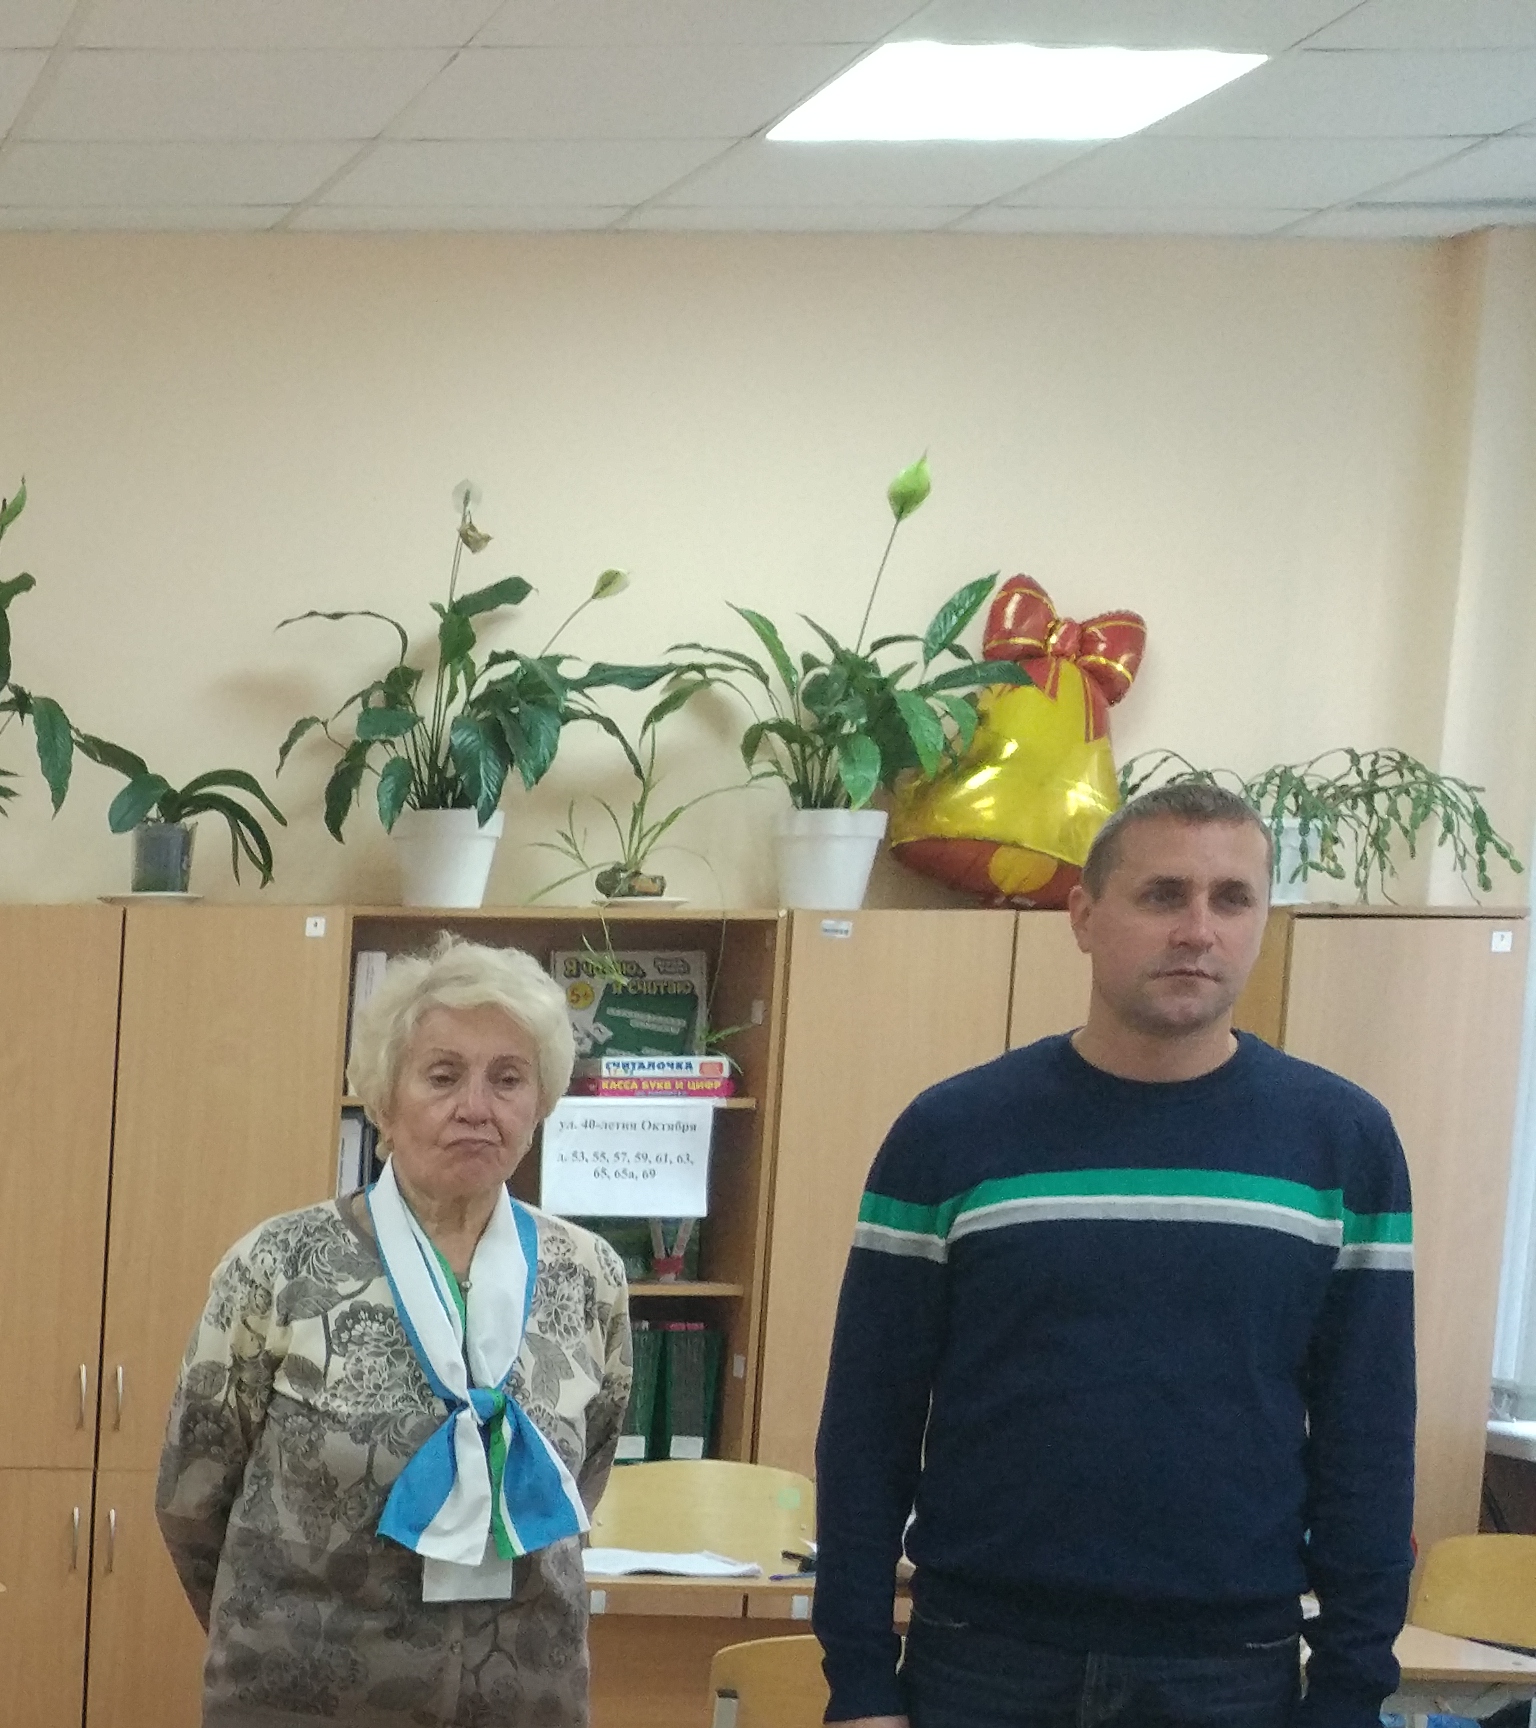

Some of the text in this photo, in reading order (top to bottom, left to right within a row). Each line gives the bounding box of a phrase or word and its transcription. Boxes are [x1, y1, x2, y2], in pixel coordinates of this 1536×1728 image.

[605, 1061, 694, 1071] СЧИТАЛОЧКА
[601, 1080, 722, 1090] КАССА БУКВ И ЦИФР
[559, 1118, 697, 1133] ул. 40-летия Октября
[571, 1150, 588, 1164] 53,
[592, 1151, 609, 1164] 55,
[613, 1151, 630, 1164] 57,
[634, 1152, 651, 1164] 59,
[655, 1152, 673, 1165] 61,
[676, 1152, 694, 1165] 63,
[593, 1166, 611, 1180] 65,
[642, 1168, 656, 1180] 69
